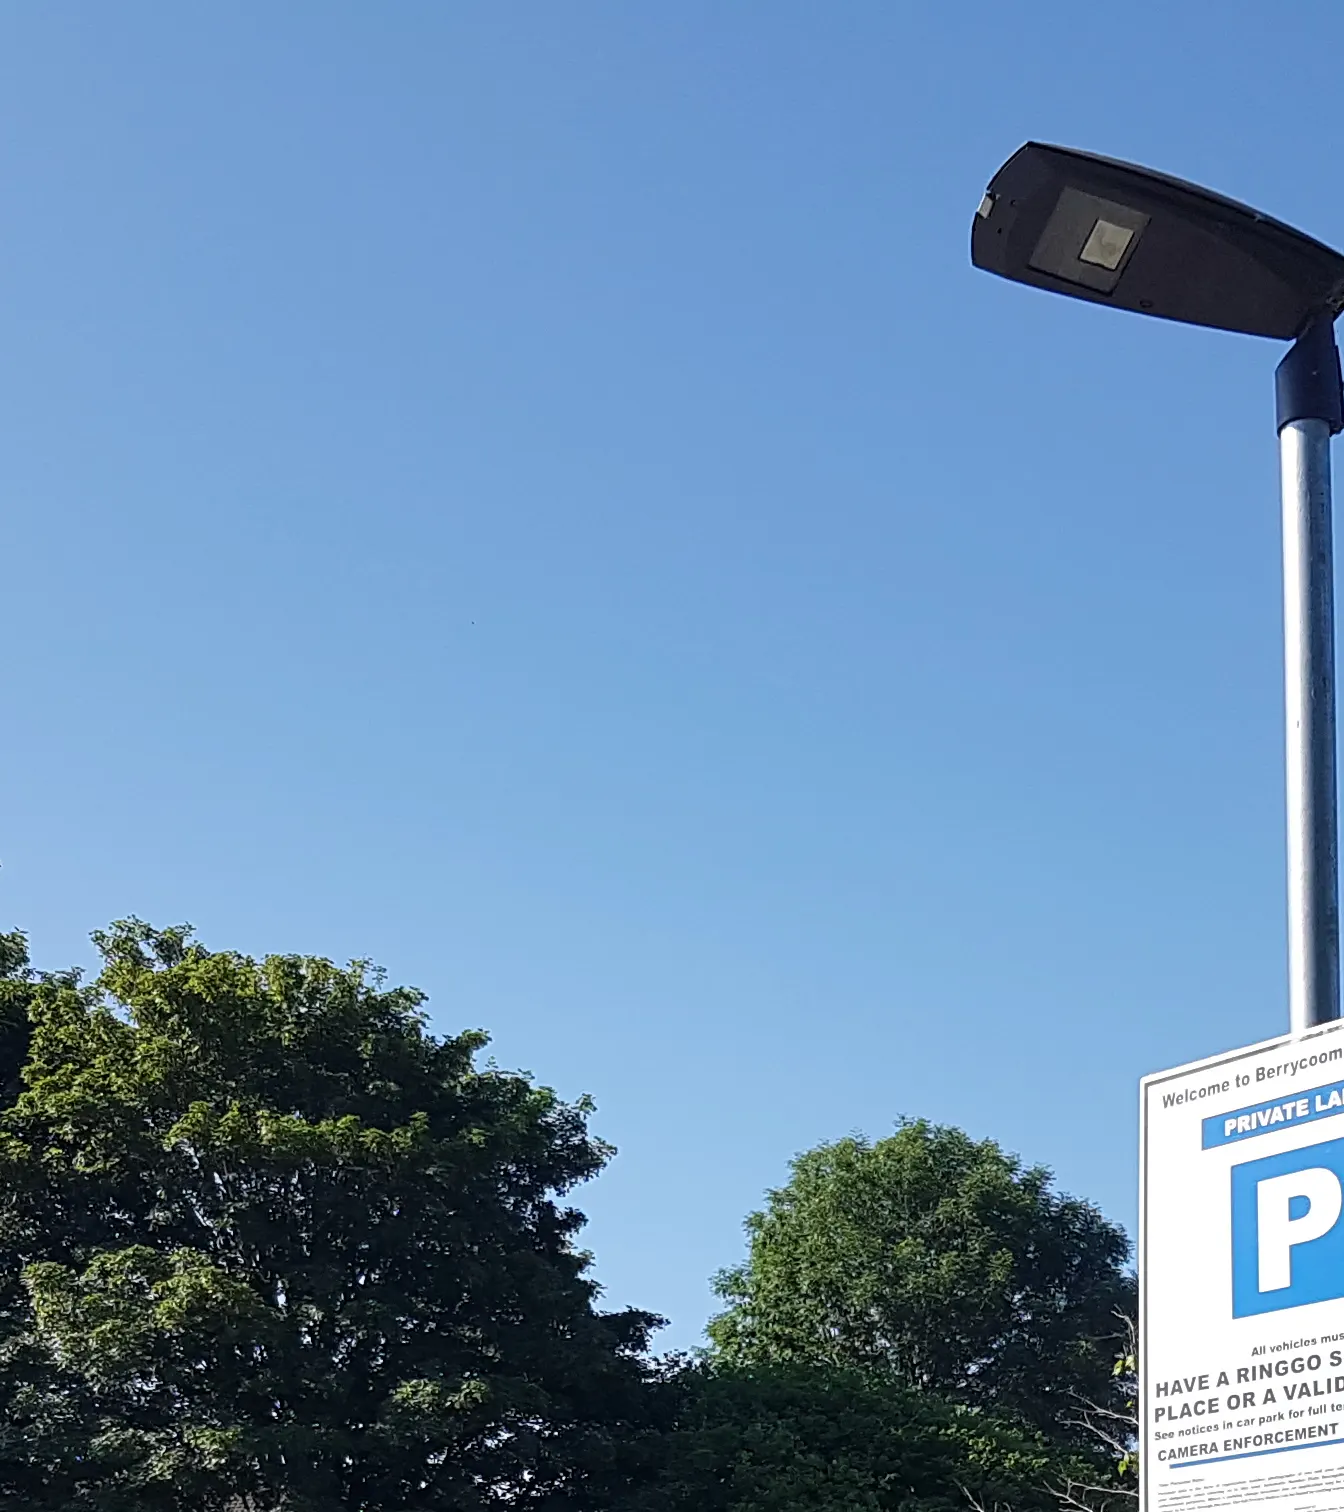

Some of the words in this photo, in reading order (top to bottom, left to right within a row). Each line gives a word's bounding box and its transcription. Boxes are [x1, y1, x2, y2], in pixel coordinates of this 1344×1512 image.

[1162, 1078, 1230, 1109] Welcome
[1235, 1074, 1251, 1089] to
[1224, 1098, 1309, 1137] PRIVATE
[1257, 1167, 1343, 1294] P
[1251, 1345, 1266, 1357] All
[1269, 1337, 1318, 1354] vehicles
[1156, 1374, 1210, 1398] HAVE
[1216, 1371, 1230, 1388] A
[1237, 1354, 1322, 1384] RINGGO
[1154, 1397, 1219, 1423] PLACE
[1227, 1391, 1256, 1410] OR
[1262, 1388, 1277, 1405] A
[1154, 1431, 1174, 1441] See
[1178, 1423, 1219, 1437] notices
[1223, 1420, 1233, 1430] in
[1236, 1417, 1255, 1428] car
[1259, 1411, 1285, 1426] park
[1288, 1408, 1305, 1419] for
[1308, 1404, 1327, 1416] full
[1157, 1442, 1219, 1462] CAMERA
[1224, 1422, 1339, 1452] ENFORCEMENT
